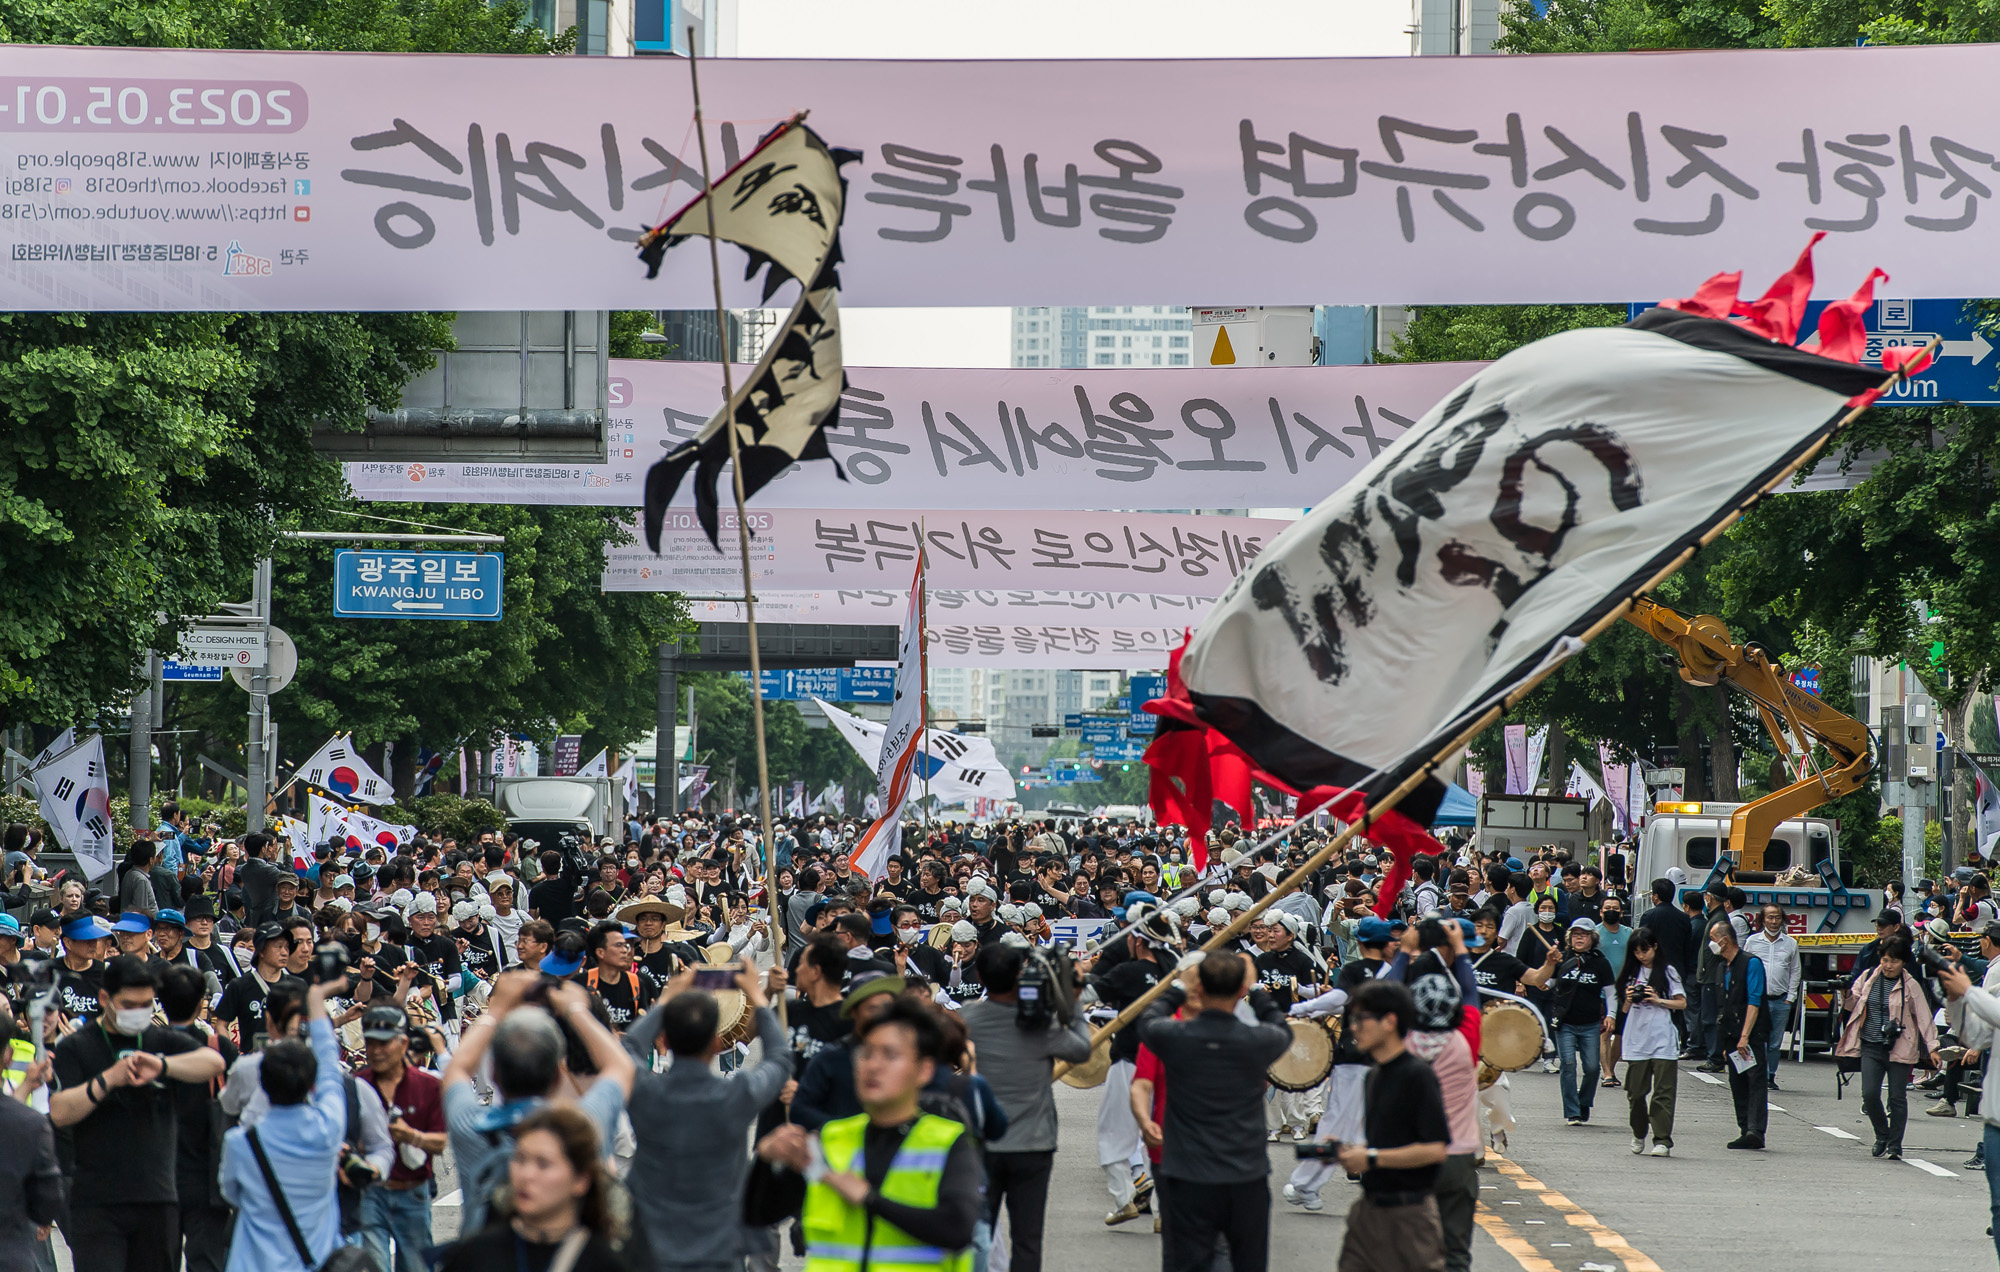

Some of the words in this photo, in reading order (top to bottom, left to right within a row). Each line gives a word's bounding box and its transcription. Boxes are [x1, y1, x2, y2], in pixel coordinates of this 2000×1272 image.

[356, 557, 482, 584] 광주일보
[351, 586, 437, 600] KWANGJU
[445, 587, 485, 601] ILBO
[205, 636, 235, 645] DESIGN
[235, 637, 259, 646] HOTEL
[200, 652, 235, 662] 주차장입구
[851, 669, 892, 679] 고속도로
[1784, 688, 1802, 703] DHS
